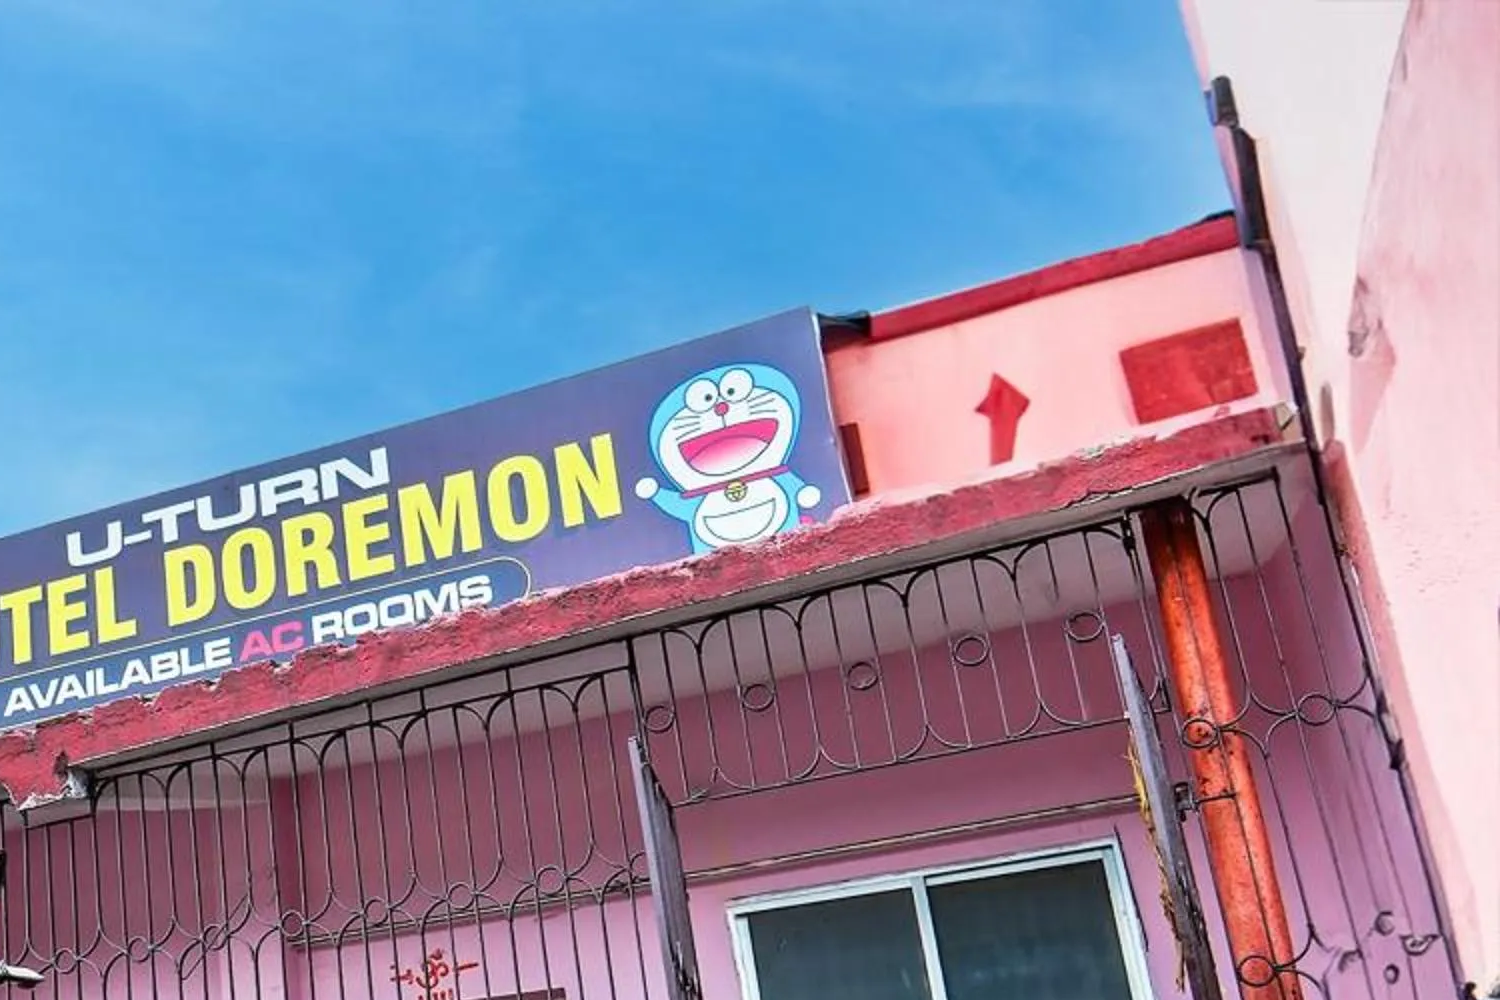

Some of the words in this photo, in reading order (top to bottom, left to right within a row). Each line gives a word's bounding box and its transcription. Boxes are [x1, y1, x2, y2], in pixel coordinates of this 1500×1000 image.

[66, 447, 390, 567] U-TURN
[162, 432, 623, 627] DOREMON
[3, 637, 233, 717] AVAILABLE
[239, 621, 305, 663] AC
[311, 574, 493, 646] ROOMS
